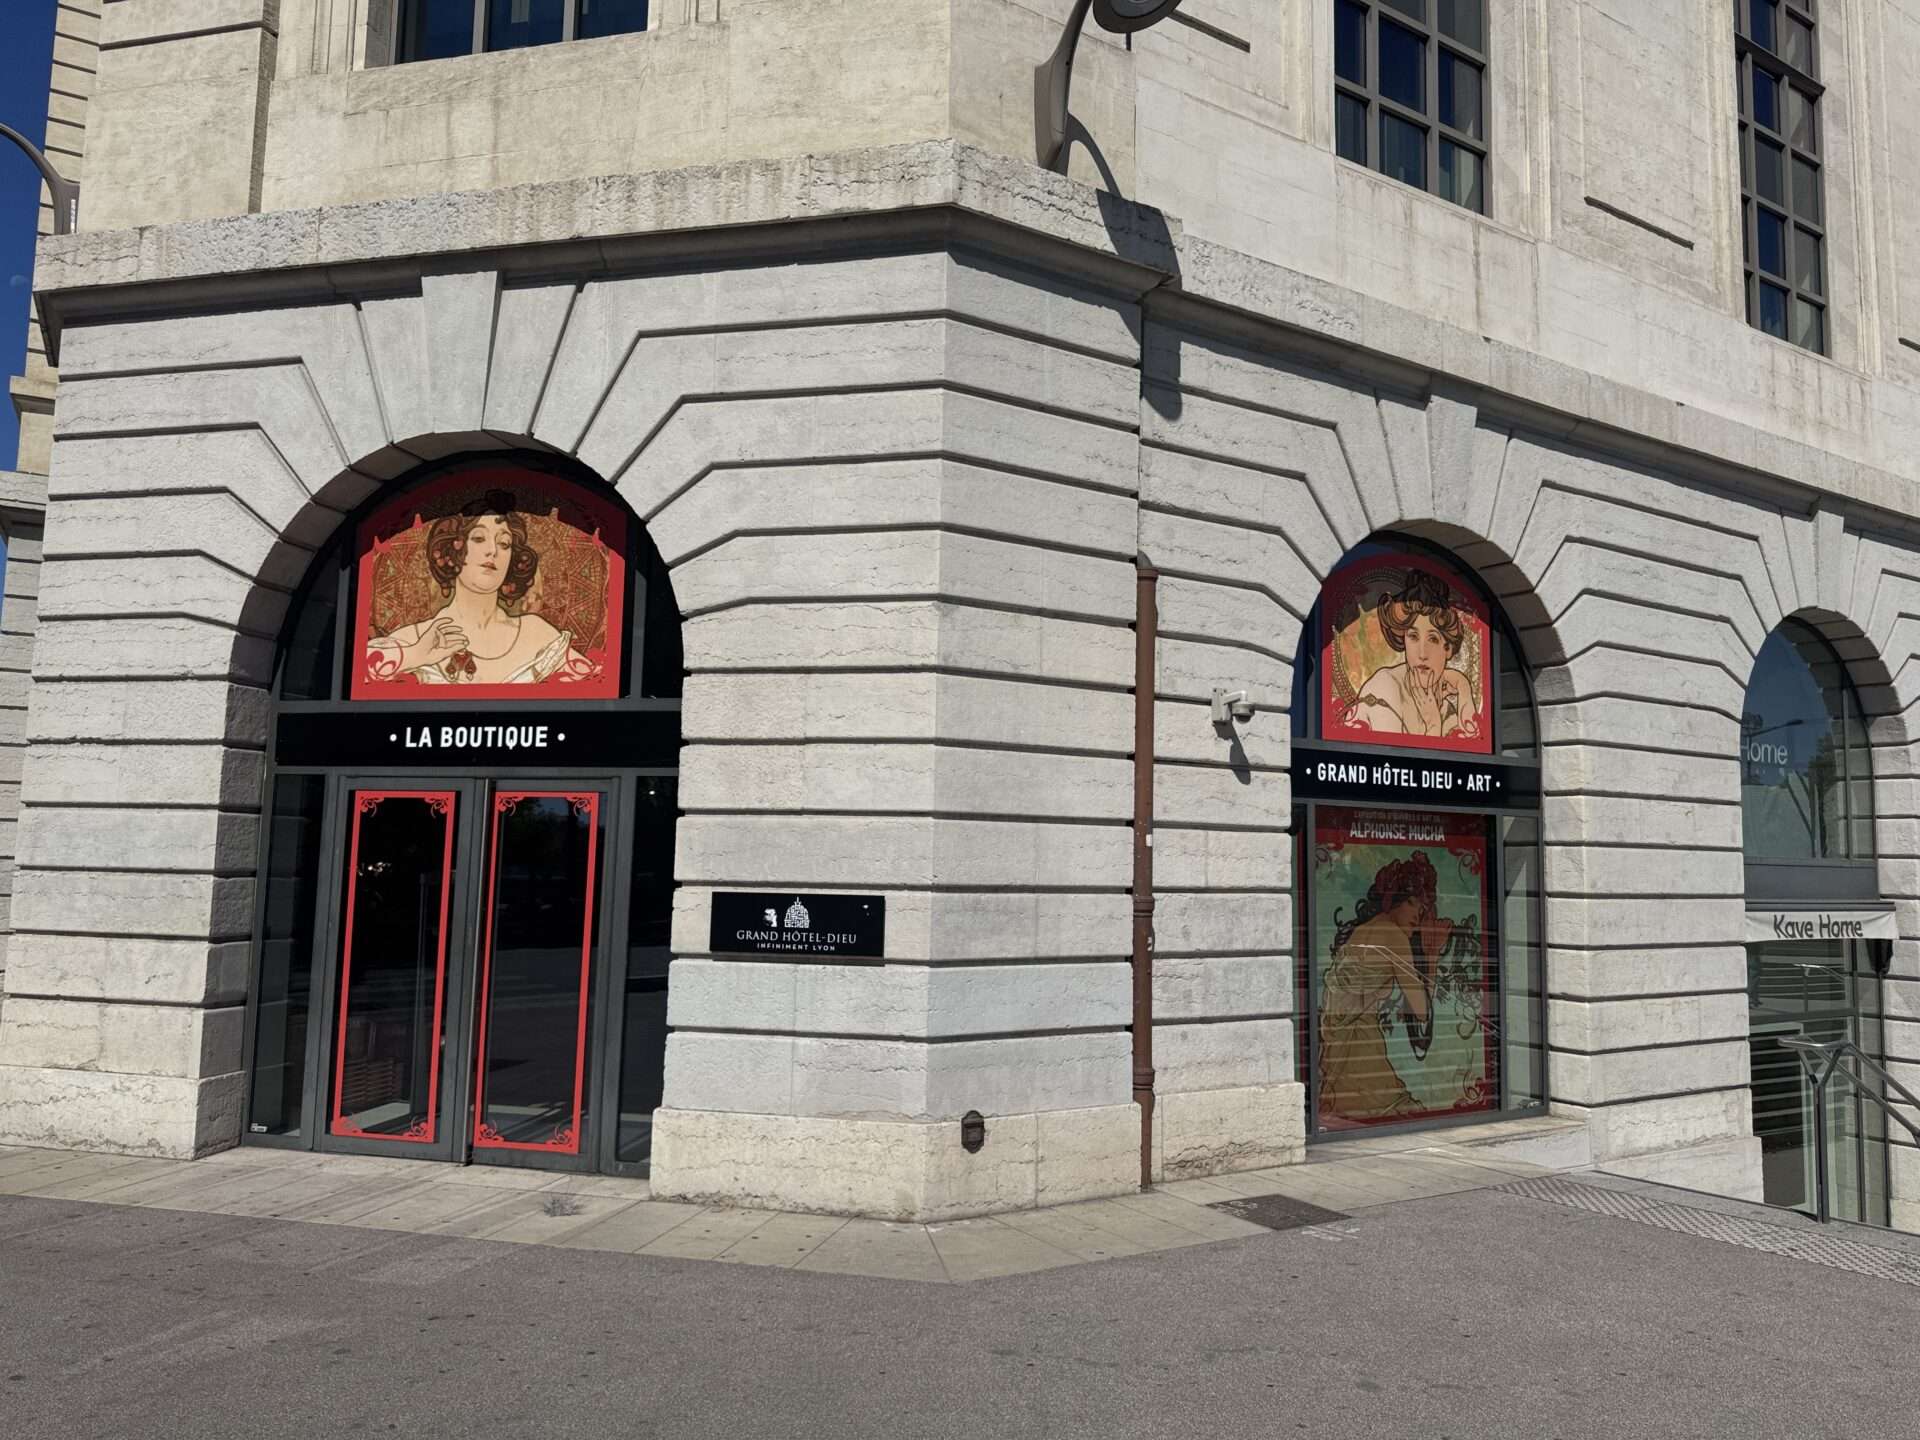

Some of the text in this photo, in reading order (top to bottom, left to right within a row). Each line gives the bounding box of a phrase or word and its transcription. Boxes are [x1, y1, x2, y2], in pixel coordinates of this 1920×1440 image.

[405, 726, 549, 750] LA BOUTIQUE
[1317, 762, 1492, 792] GRAND HÔTEL DIEU ART
[1350, 822, 1446, 842] ALPHONSE MUCHA
[736, 930, 857, 944] GRAND HÔTEL-DIEU
[1773, 914, 1864, 938] Kave Home
[757, 942, 809, 951] INFINIMENT
